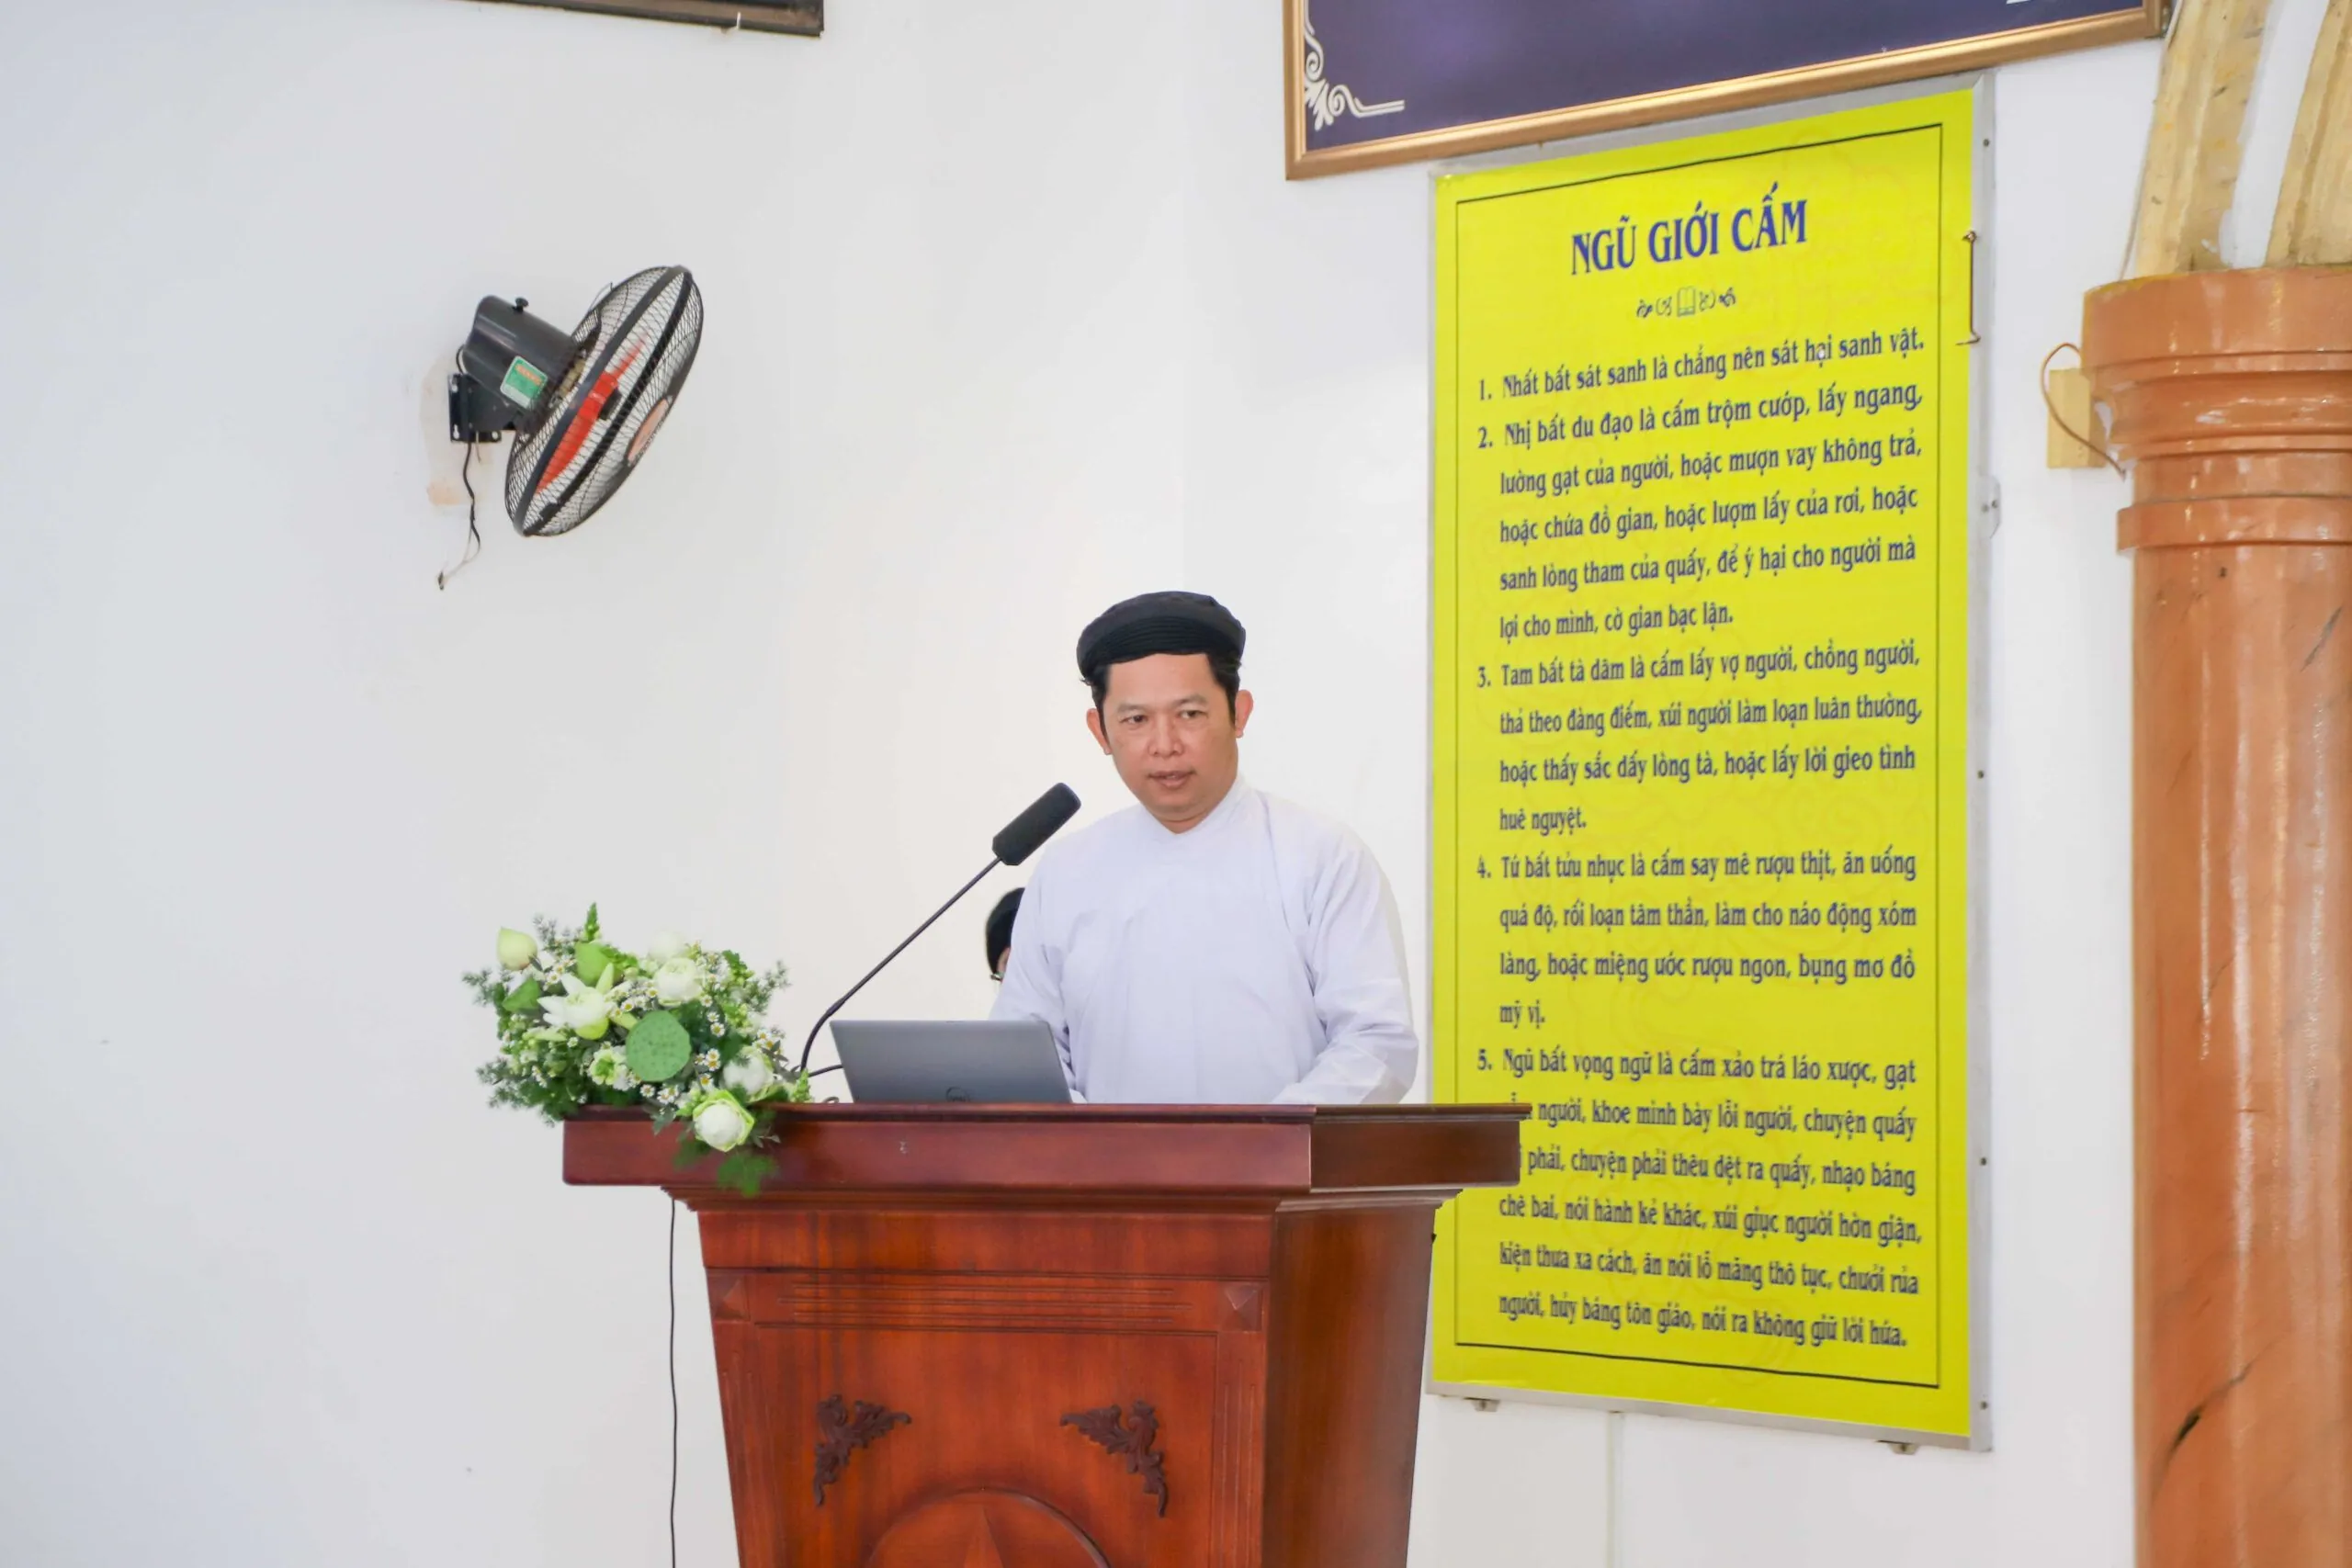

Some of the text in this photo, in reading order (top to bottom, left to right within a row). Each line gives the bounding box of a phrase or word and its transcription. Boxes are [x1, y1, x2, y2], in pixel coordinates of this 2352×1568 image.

[1571, 180, 1808, 276] NGŨ GIỚI CẤM
[1480, 326, 1925, 401] 1. Nhất bất sát sanh là chẳng nên sát hại sanh vật.
[1477, 381, 1923, 451] 2. Nhị bất du đạo là cấm trộm cướp, lấy ngang,
[1500, 427, 1922, 499] lường gạt của người, hoặc mượn vay không trả,
[1499, 484, 1918, 547] hoặc chứa đồ gian, hoặc lượm lấy của rơi, hoặc
[1499, 566, 1538, 592] sanh
[1542, 563, 1578, 593] lòng
[1582, 560, 1625, 584] tham
[1630, 553, 1660, 581] của
[1664, 547, 1711, 585] quấy,
[1744, 547, 1755, 579] ý
[1759, 543, 1787, 577] hại
[1792, 543, 1826, 569] cho
[1830, 536, 1882, 573] người
[1887, 534, 1917, 562] mà
[1499, 601, 1734, 645] lợi cho mình, gian bạc lận.
[1477, 637, 1920, 689] 3. Tam bất tà dâm là cấm lấy vợ người, chồng người,
[1529, 709, 1563, 734] theo
[1566, 706, 1606, 739] đàng
[1609, 700, 1653, 729] điếm,
[1687, 698, 1732, 734] người
[1736, 698, 1768, 724] làm
[1772, 698, 1809, 729] loạn
[1814, 695, 1850, 721] luân
[1856, 692, 1923, 726] thường,
[1499, 760, 1538, 789] hoặc
[1543, 752, 1579, 786] thấy
[1583, 750, 1611, 780] sắc
[1616, 750, 1648, 784] dấy
[1652, 751, 1691, 784] lòng
[1724, 750, 1767, 781] hoặc
[1772, 743, 1800, 780] lấy
[1832, 744, 1874, 780] gieo
[1531, 807, 1587, 837] nguyệt.
[1476, 856, 1492, 879] 4.
[1524, 851, 1552, 878] bất
[1631, 852, 1645, 877] là
[1650, 848, 1686, 877] cấm
[1690, 857, 1720, 883] say
[1724, 852, 1751, 876] mê
[1870, 843, 1917, 883] uống
[1498, 903, 1529, 934] quá
[1533, 903, 1558, 933] độ,
[1589, 903, 1625, 933] loạn
[1629, 903, 1662, 927] tâm
[1714, 901, 1747, 927] làm
[1751, 901, 1784, 927] cho
[1826, 901, 1872, 934] động
[1877, 900, 1917, 927] xóm
[1547, 952, 1589, 982] hoặc
[1594, 950, 1650, 984] miệng
[1739, 958, 1792, 985] ngon,
[1798, 953, 1849, 986] bụng
[1853, 958, 1884, 978] mơ
[1476, 1048, 1493, 1071] 5.
[1539, 1044, 1568, 1073] bất
[1572, 1055, 1614, 1081] vọng
[1657, 1051, 1674, 1076] là
[1679, 1047, 1717, 1077] cấm
[1883, 1059, 1917, 1091] gạt
